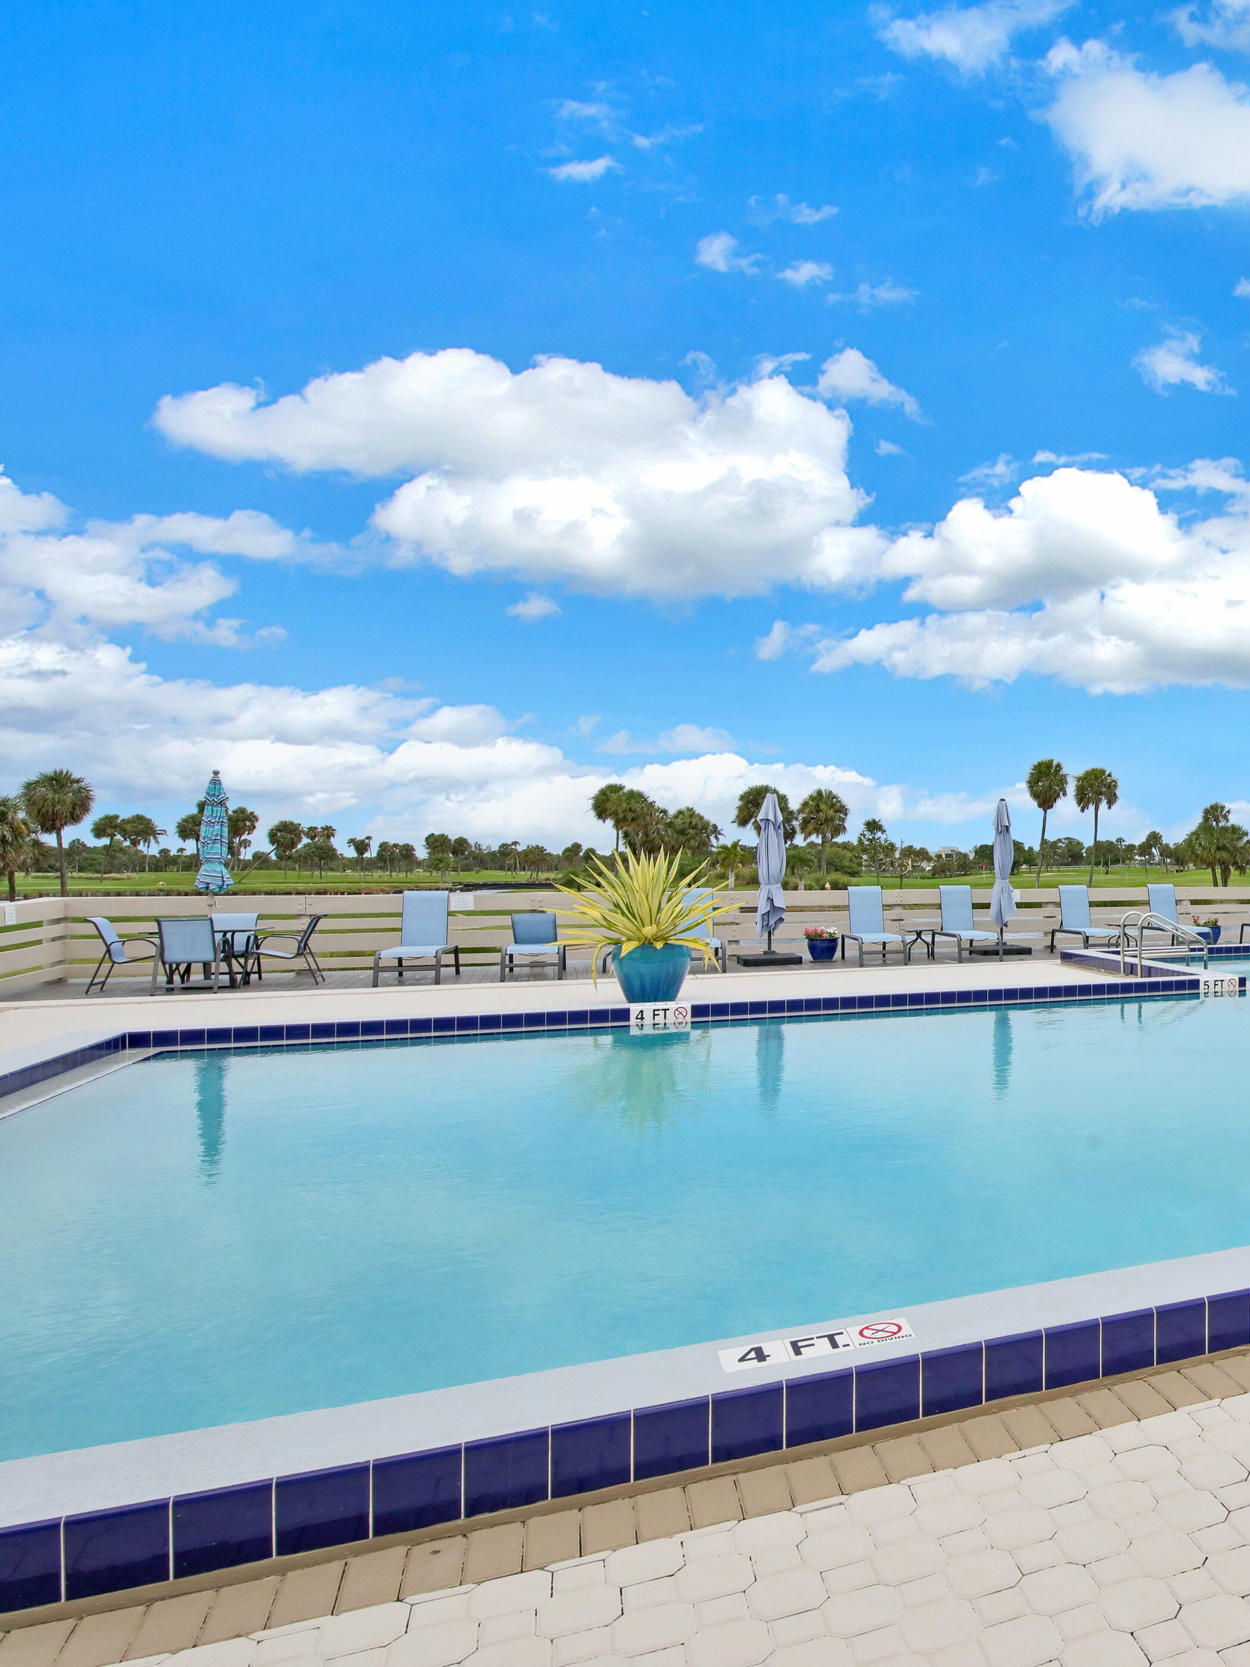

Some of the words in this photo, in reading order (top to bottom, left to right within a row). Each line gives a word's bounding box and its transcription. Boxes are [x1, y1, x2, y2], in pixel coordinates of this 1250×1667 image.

[1213, 979, 1225, 991] FT
[634, 1009, 645, 1021] 4
[652, 1008, 670, 1020] FT
[877, 1333, 913, 1343] DIVING
[737, 1345, 771, 1363] 4
[789, 1331, 850, 1357] FT.
